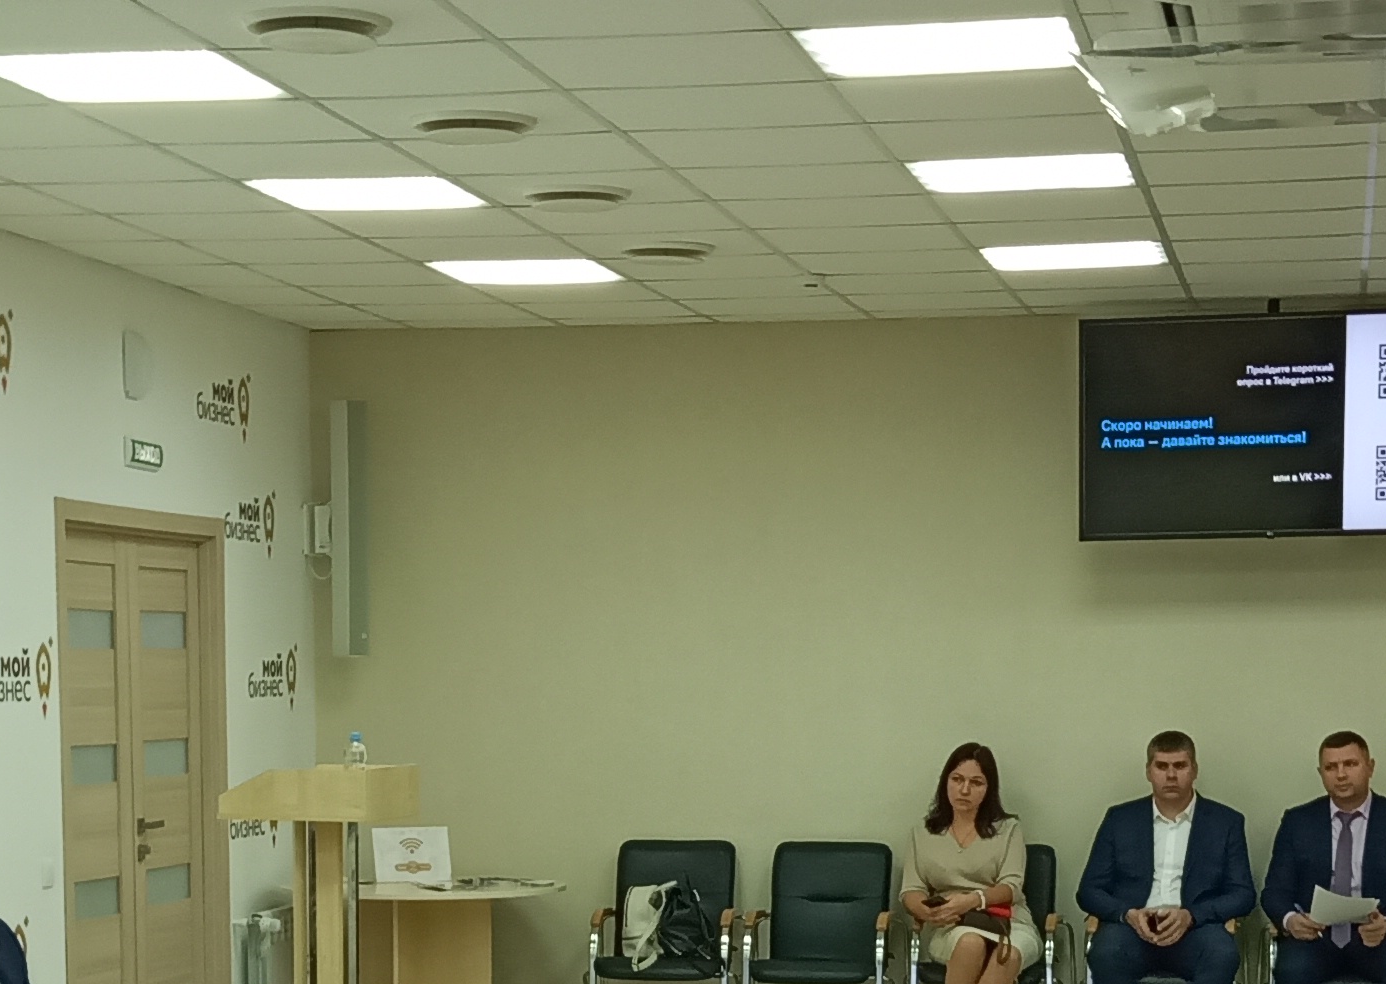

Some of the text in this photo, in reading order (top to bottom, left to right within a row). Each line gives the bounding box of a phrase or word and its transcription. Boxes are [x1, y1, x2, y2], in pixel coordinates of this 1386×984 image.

[212, 379, 235, 405] мой
[196, 391, 236, 426] бизнес
[1101, 416, 1213, 433] Скоро начинаем!
[1101, 437, 1112, 449] А
[1114, 438, 1145, 448] пока
[1161, 434, 1215, 448] давайте
[1217, 430, 1307, 446] знакомиться!
[1298, 471, 1313, 482] VK
[239, 497, 260, 523] мой
[224, 512, 261, 543] бизнес
[0, 648, 31, 678] мой
[263, 653, 283, 678] мой
[248, 672, 284, 698] бизнес
